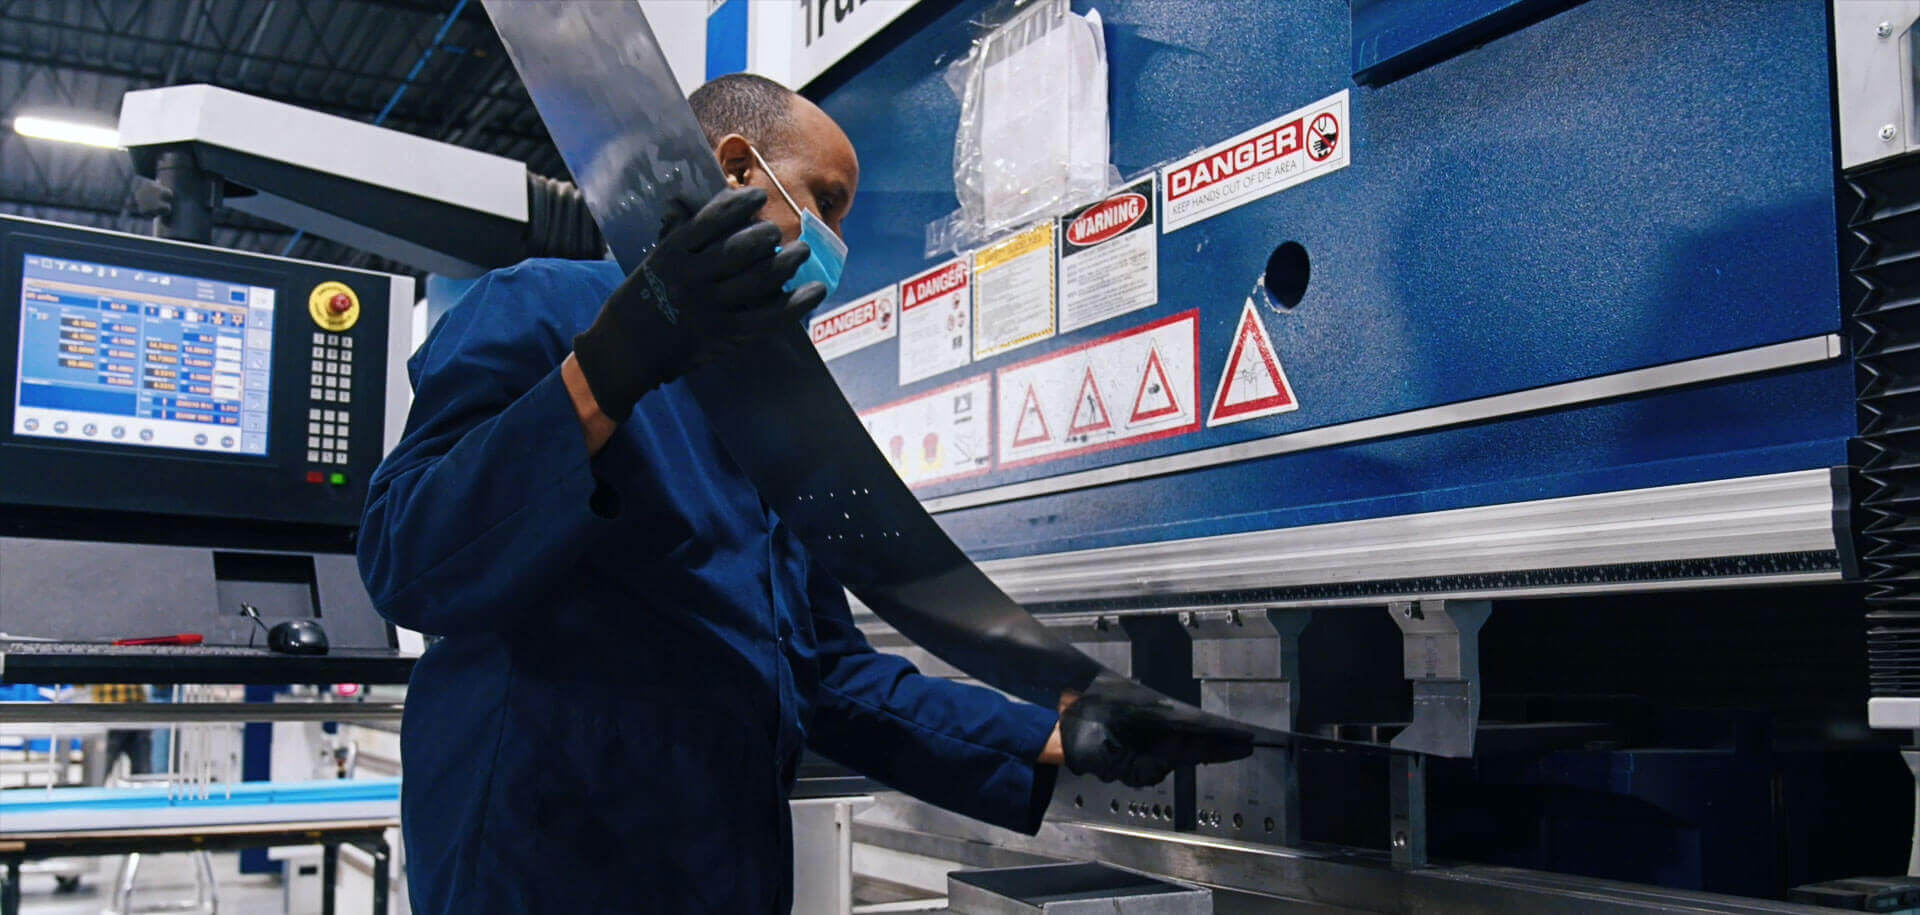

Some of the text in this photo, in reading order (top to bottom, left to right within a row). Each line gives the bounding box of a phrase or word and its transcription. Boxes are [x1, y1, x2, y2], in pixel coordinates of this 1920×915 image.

[801, 0, 867, 47] Tru
[1172, 124, 1298, 197] DANGER
[1172, 159, 1297, 215] KEEP HANDS OUT OF DIE AREA
[1074, 198, 1139, 241] WARNING
[917, 263, 967, 300] DANGER
[814, 304, 874, 341] DANGER
